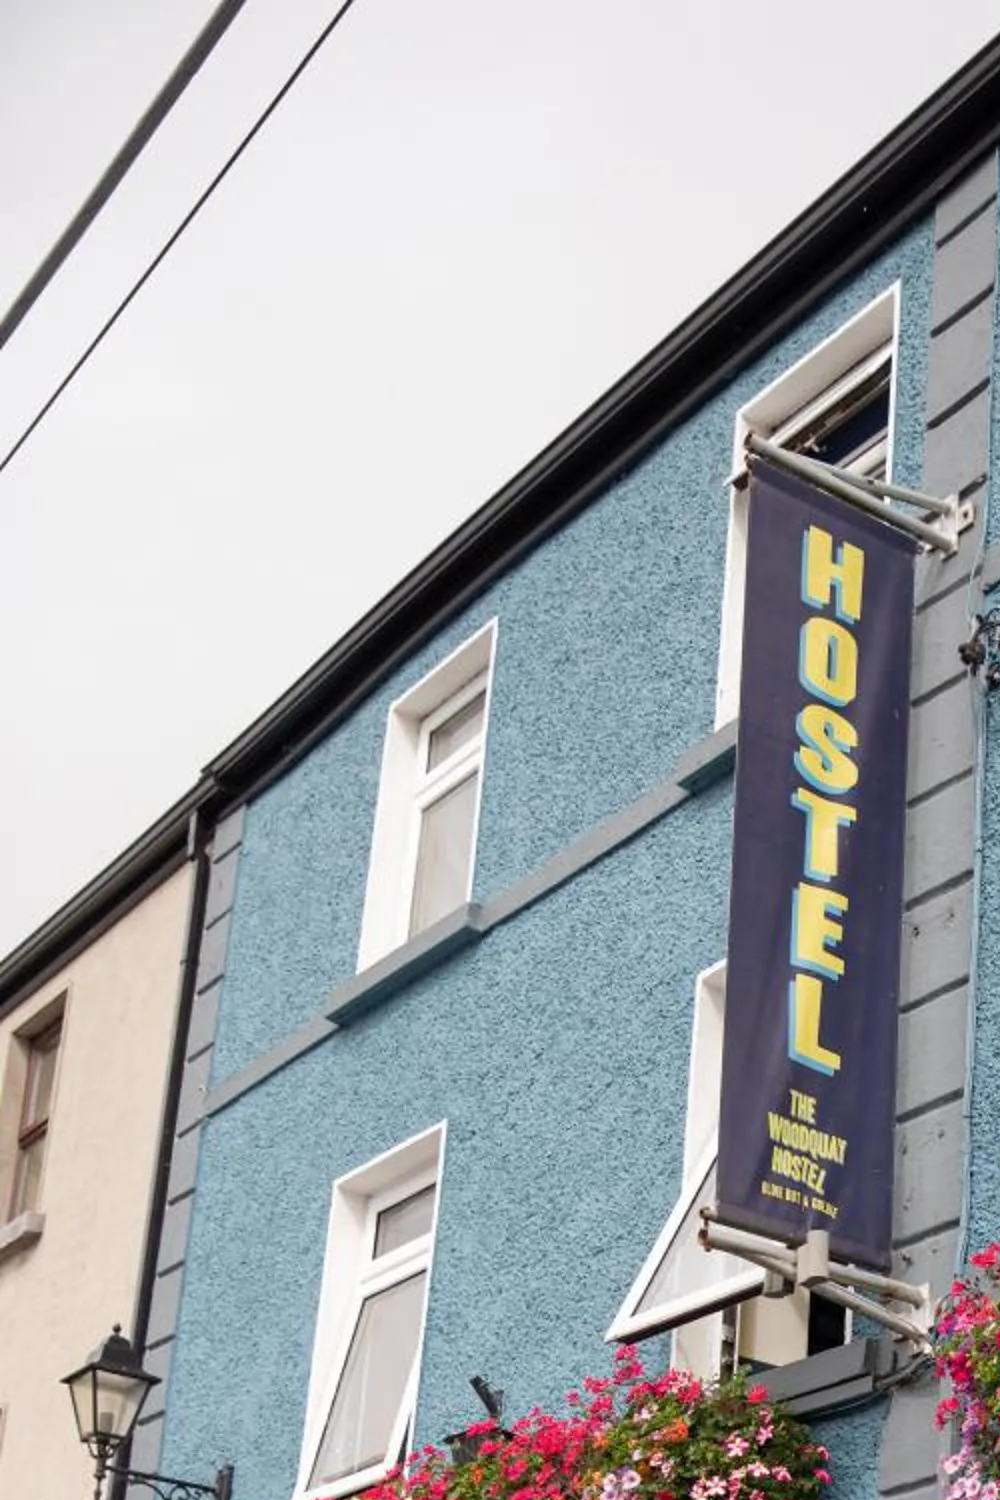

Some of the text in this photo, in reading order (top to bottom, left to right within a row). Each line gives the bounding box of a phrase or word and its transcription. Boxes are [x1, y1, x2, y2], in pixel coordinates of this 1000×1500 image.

[787, 524, 866, 1076] HOSTEL
[790, 1088, 817, 1124] THE
[768, 1111, 848, 1165] WOODQUAY
[771, 1145, 826, 1195] HOSTEL
